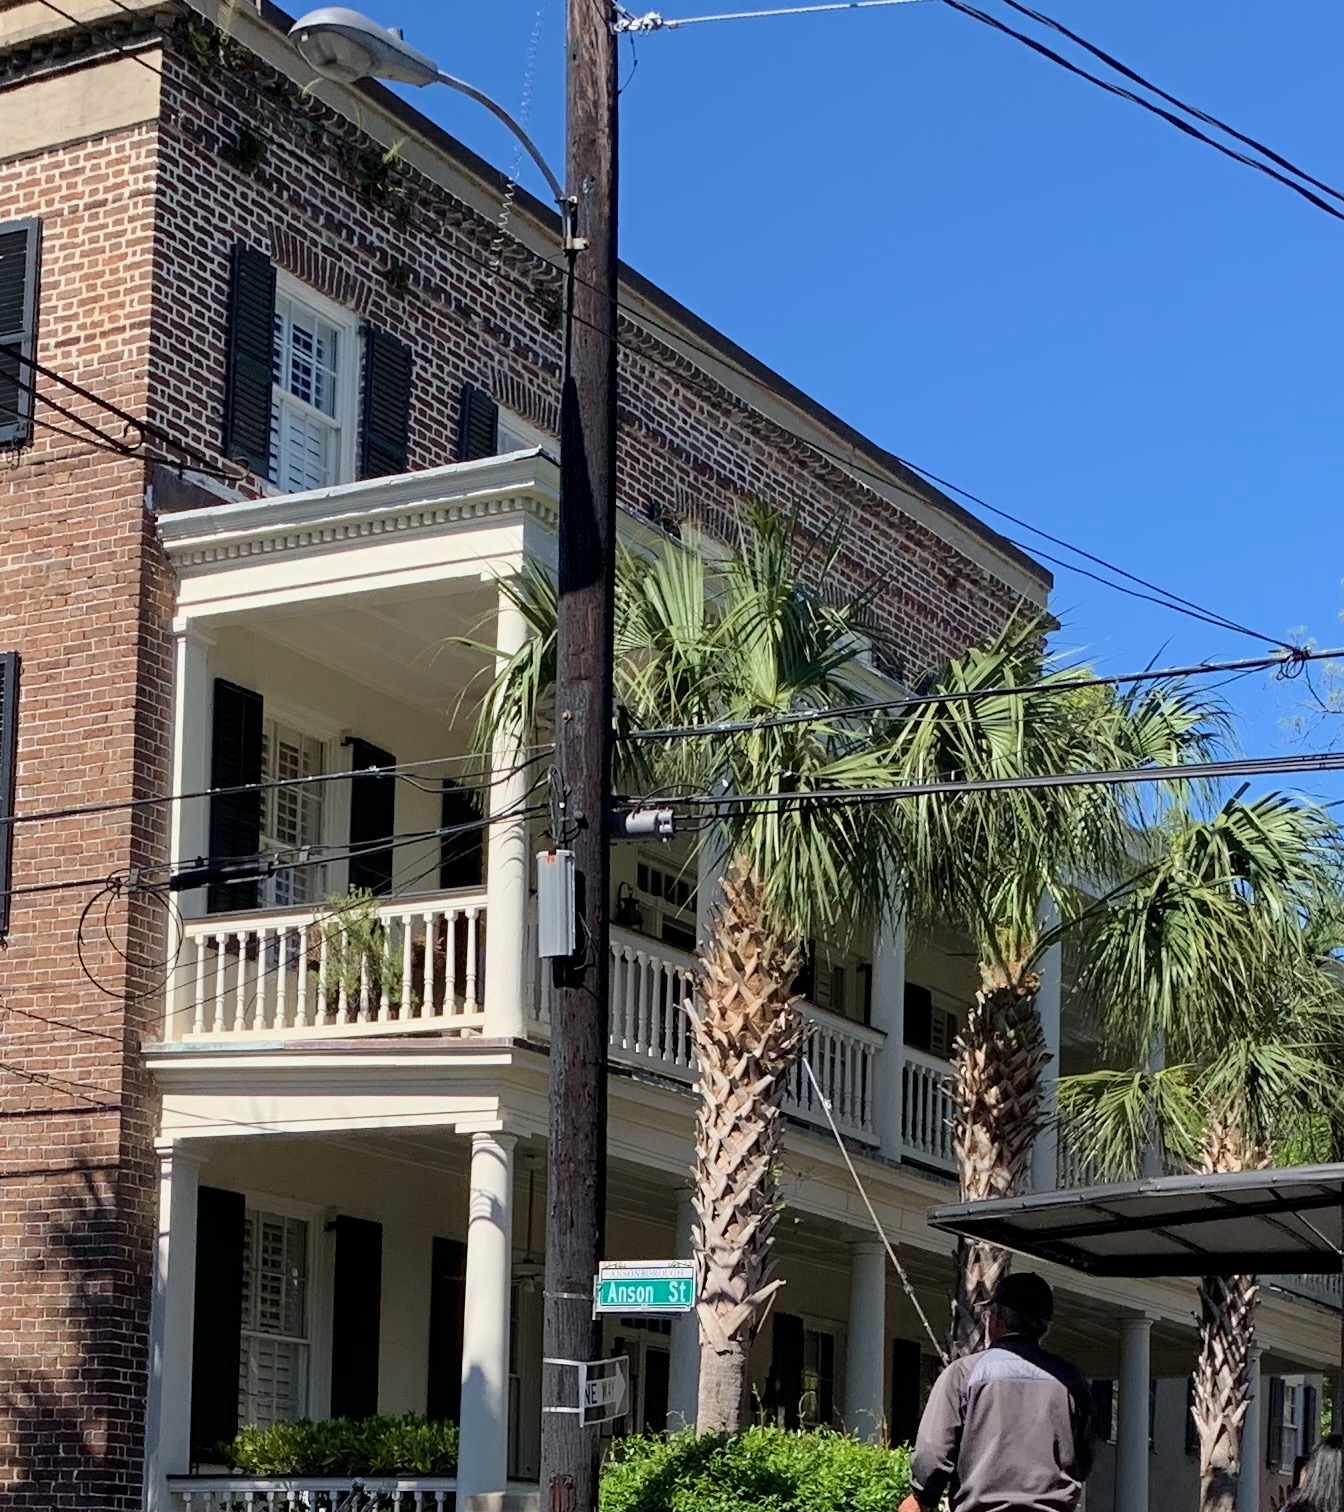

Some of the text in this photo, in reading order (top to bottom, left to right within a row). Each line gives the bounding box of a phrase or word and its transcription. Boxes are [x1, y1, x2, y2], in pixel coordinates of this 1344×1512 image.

[609, 1269, 684, 1278] ANSONBOROUGH
[607, 1280, 686, 1303] Anson St
[585, 1383, 598, 1405] NE
